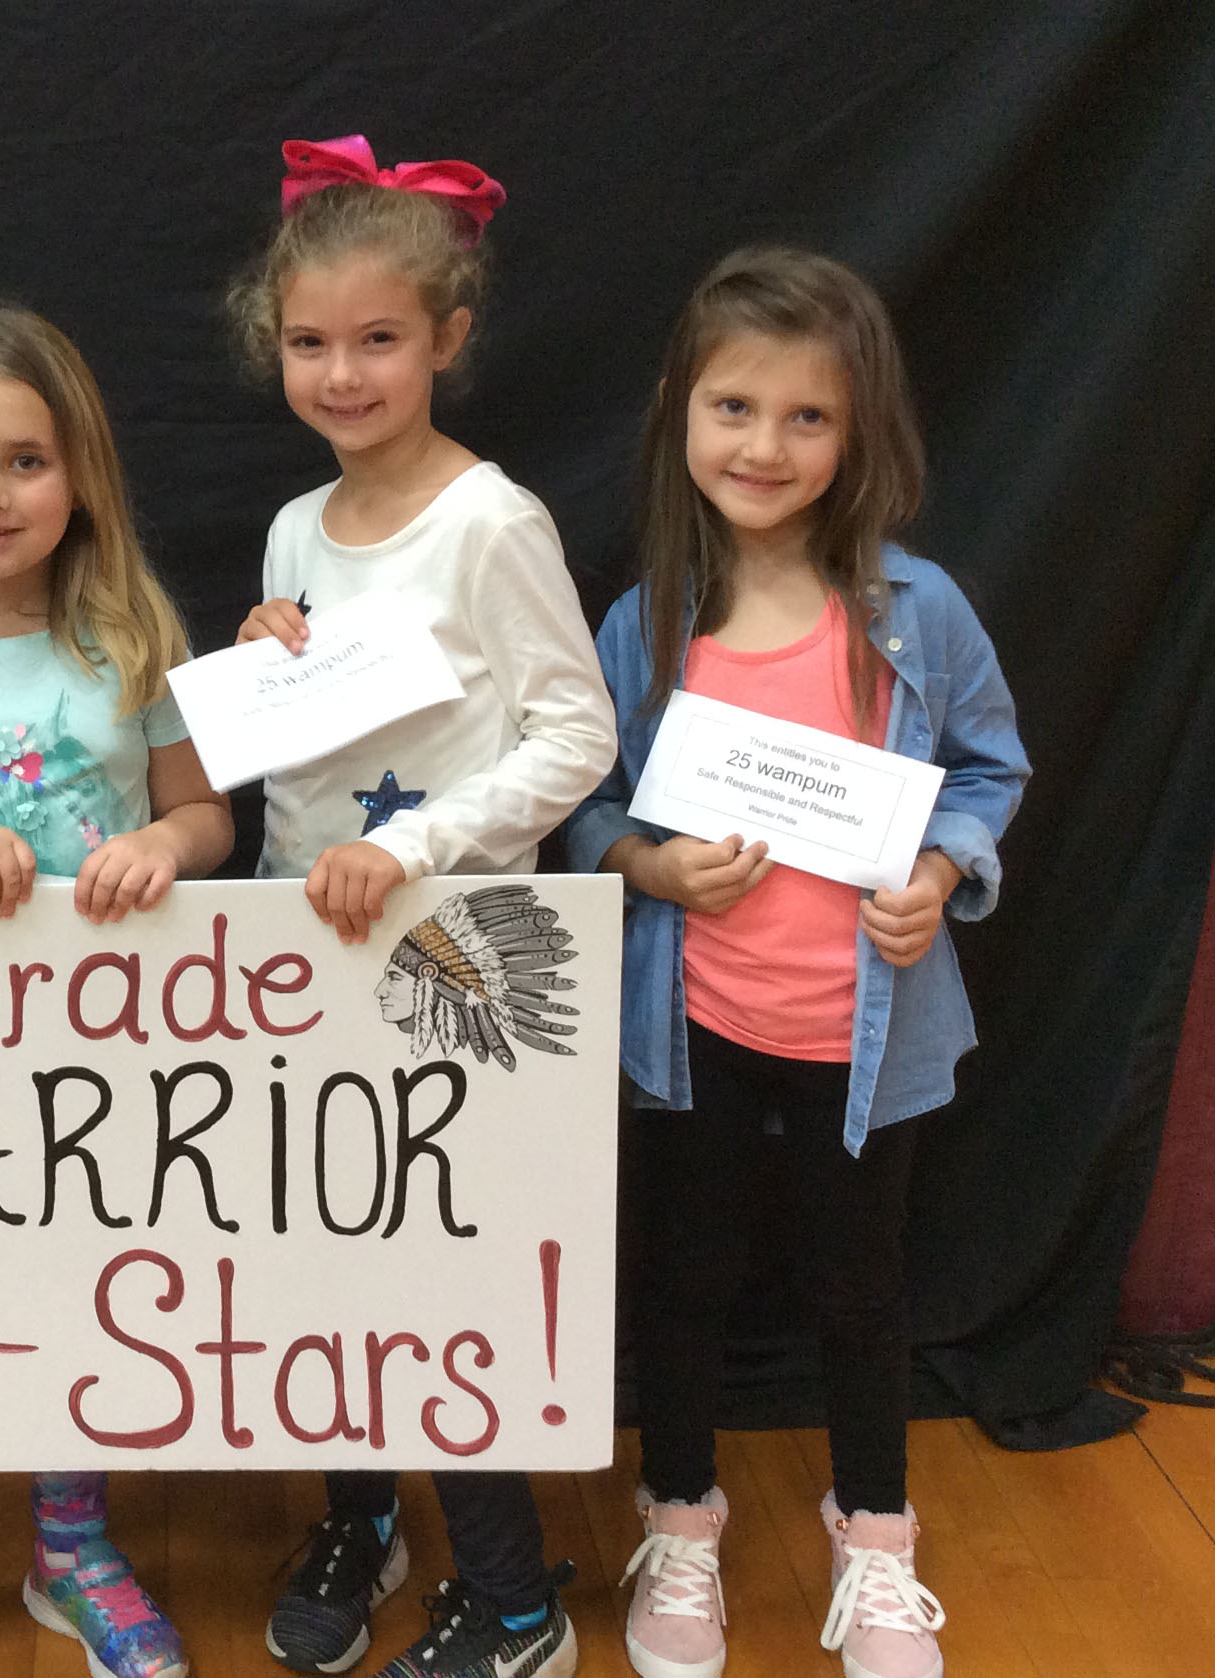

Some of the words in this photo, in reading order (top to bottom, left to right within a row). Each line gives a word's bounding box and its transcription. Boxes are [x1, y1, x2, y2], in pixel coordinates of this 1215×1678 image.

[282, 640, 365, 687] wampum
[725, 749, 752, 770] 25
[757, 760, 848, 801] wampum
[749, 736, 768, 750] This
[771, 745, 807, 762] entitles
[809, 756, 828, 769] you
[830, 761, 841, 772] to
[724, 775, 786, 803] Responsible
[787, 796, 809, 810] and
[809, 801, 864, 827] Respectful
[748, 803, 776, 819] Warrior
[776, 813, 798, 826] Pride
